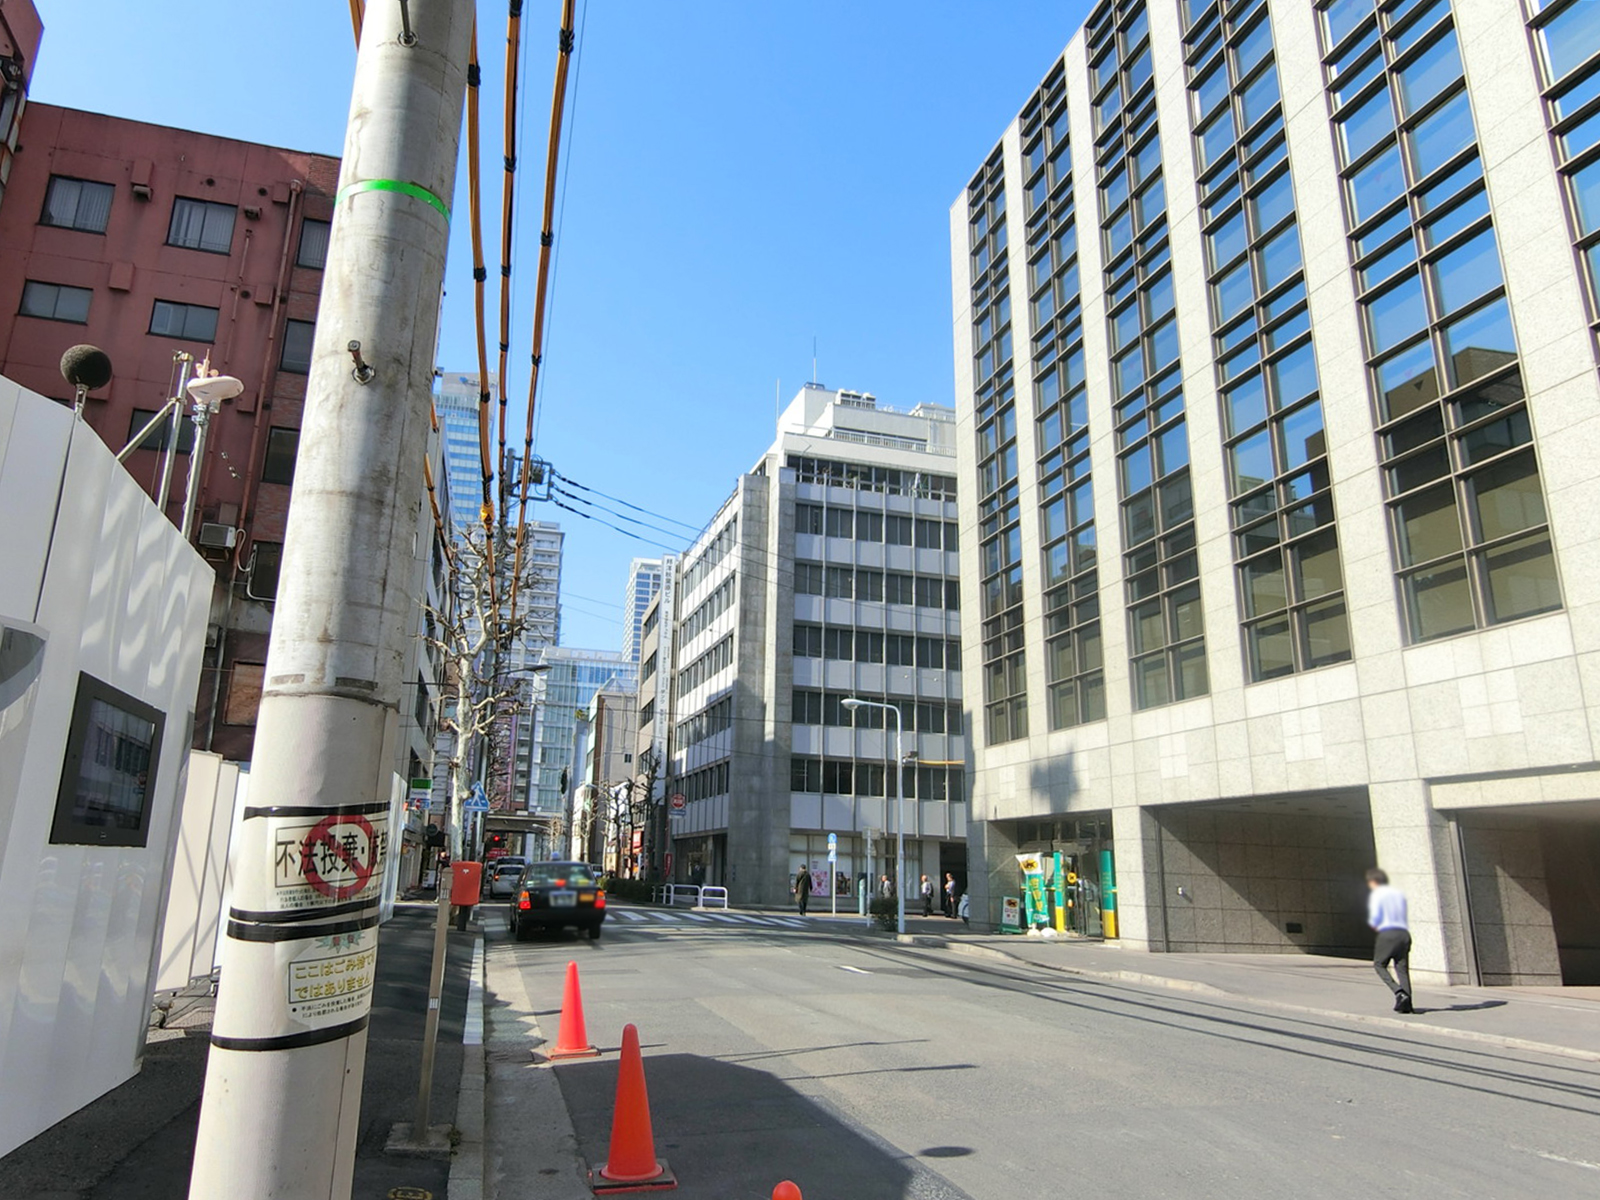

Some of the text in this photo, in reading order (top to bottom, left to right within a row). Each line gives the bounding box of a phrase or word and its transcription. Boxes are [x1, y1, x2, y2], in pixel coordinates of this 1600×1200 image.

[294, 971, 371, 999] ではありません
